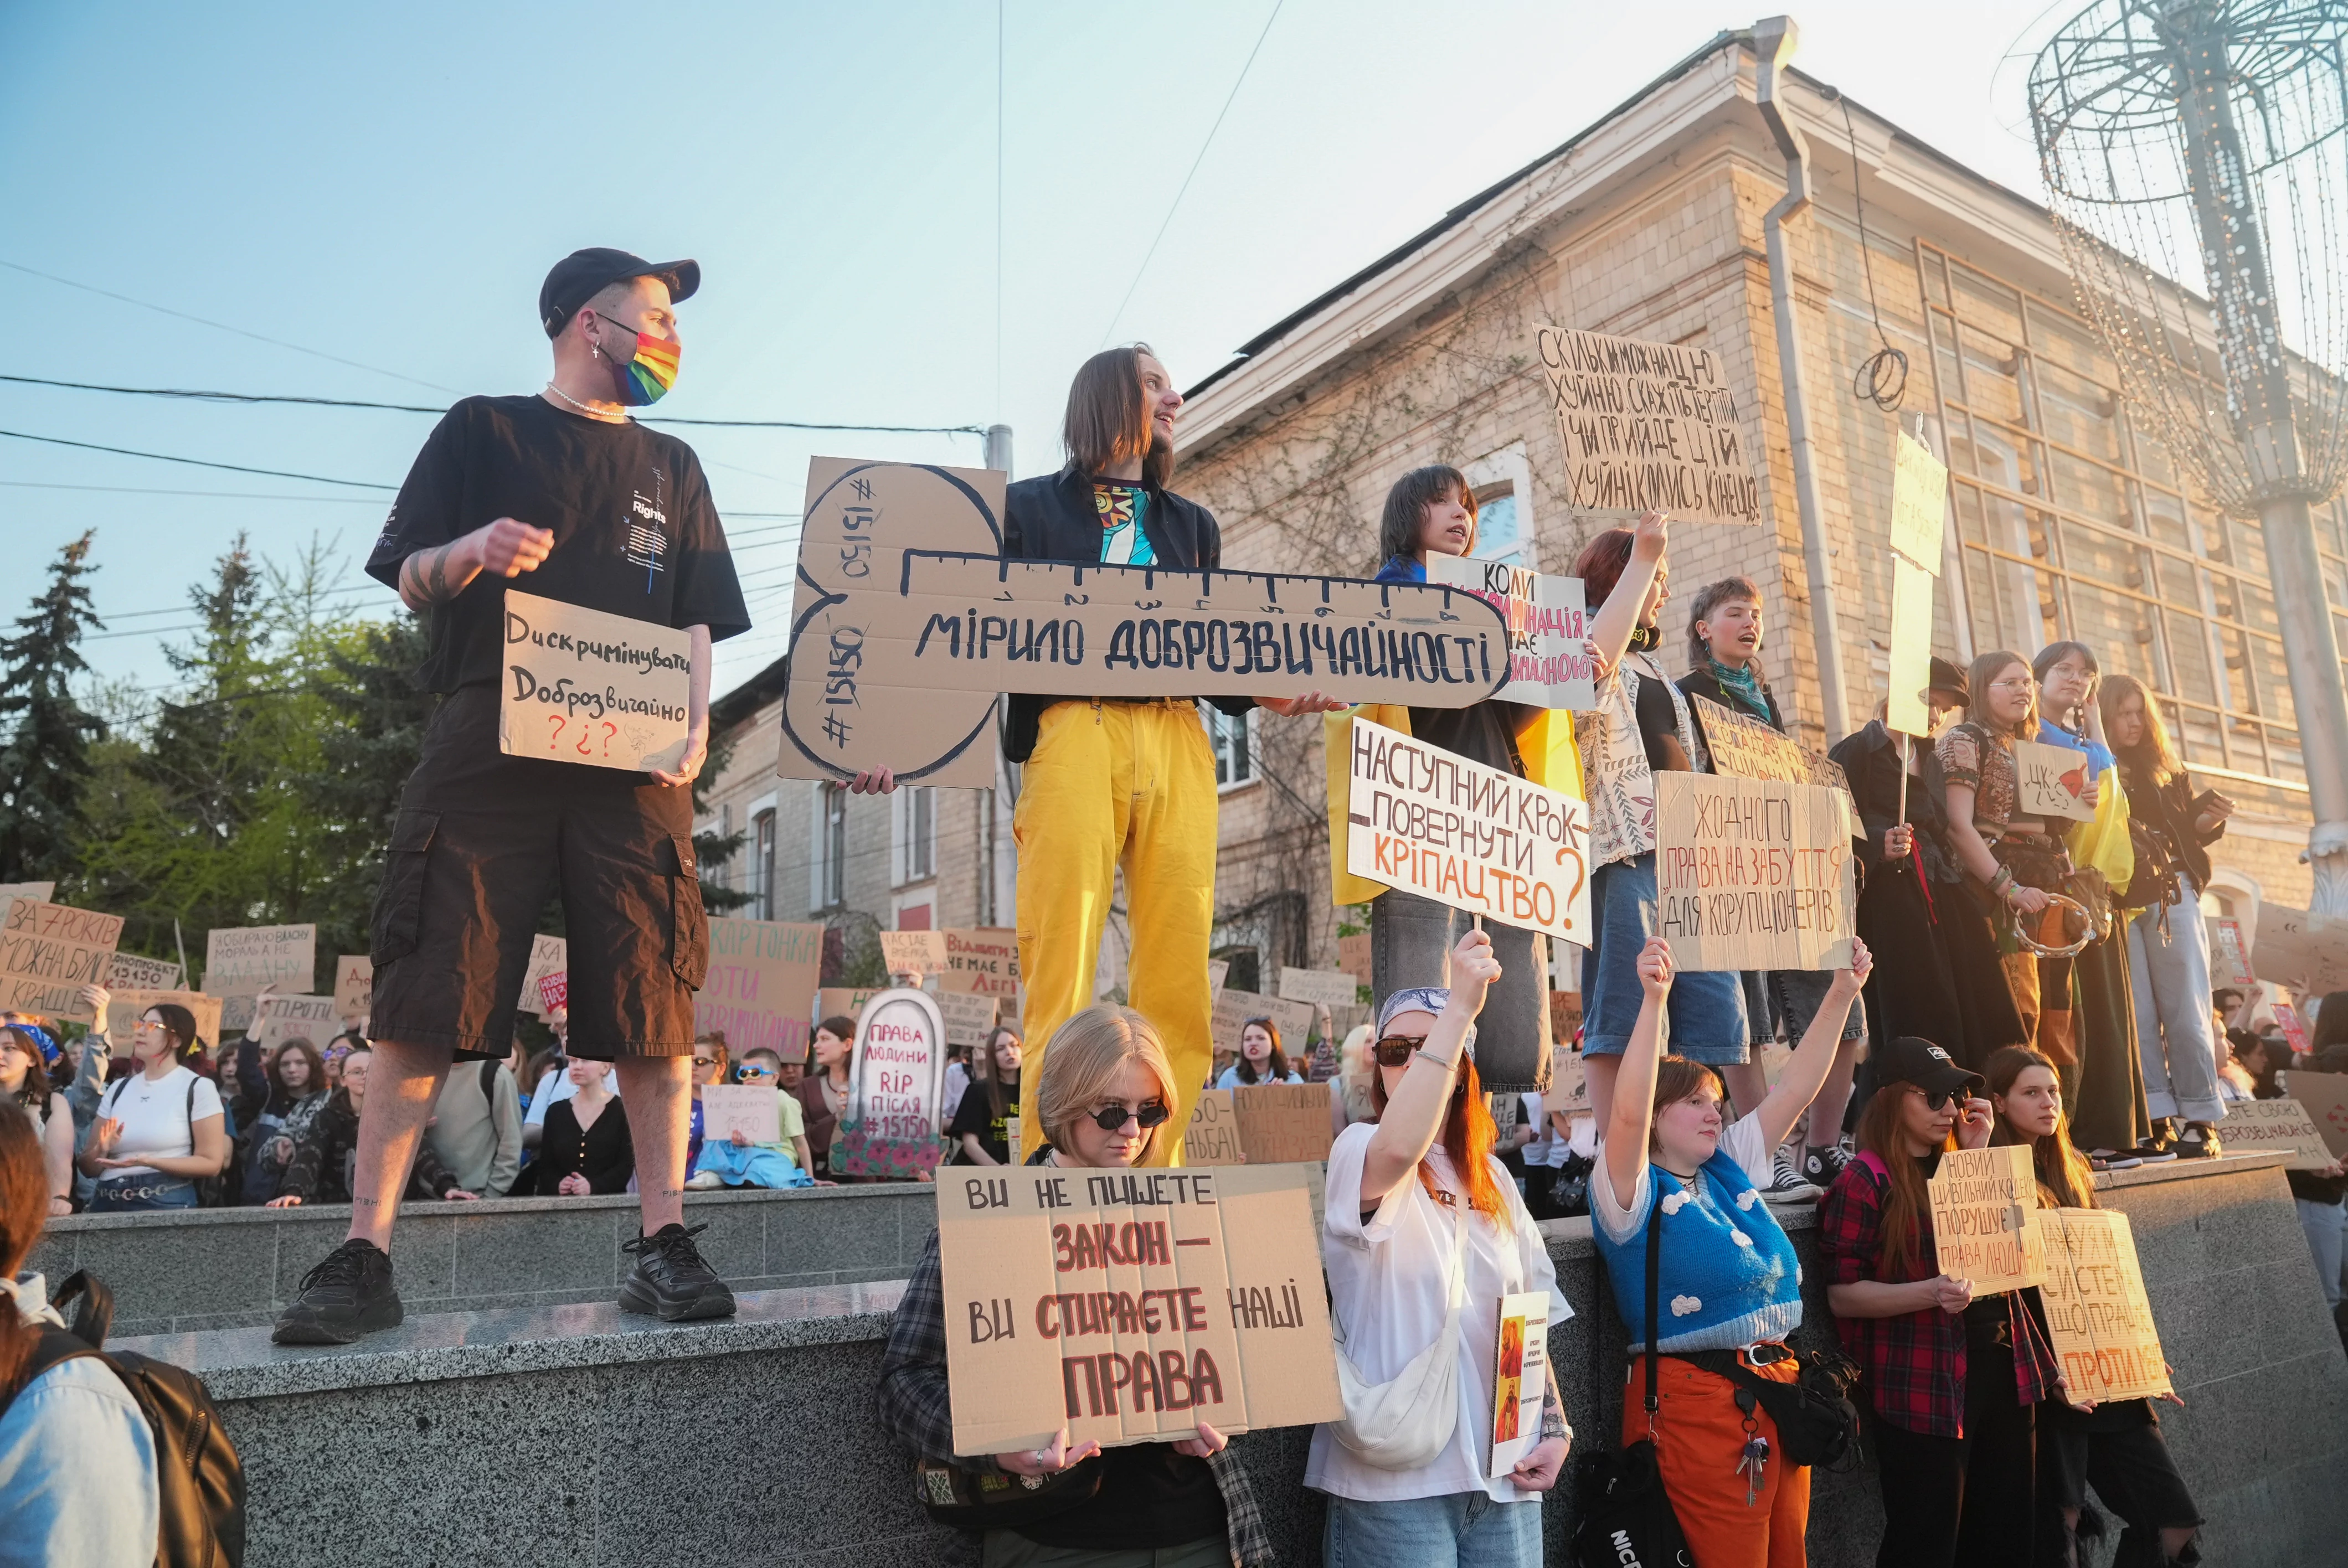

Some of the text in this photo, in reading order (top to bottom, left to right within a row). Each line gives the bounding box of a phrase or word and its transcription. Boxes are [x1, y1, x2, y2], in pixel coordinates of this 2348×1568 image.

[632, 500, 666, 524] Rights
[1484, 564, 1535, 602] КОЛИ
[1353, 726, 1510, 825] НАСТУПНИЙ
[1692, 793, 1790, 842] ЖОДНОГО
[1726, 846, 1746, 886] НА
[7, 899, 37, 933] ЗА
[40, 906, 63, 935] 7
[59, 910, 120, 945] РОКІВ
[1665, 889, 1835, 938] ДЛЯ КОРУПЦІОНЕРІВ
[870, 1024, 924, 1044] ПРАВА
[864, 1045, 928, 1064] ЛЮДИНИ
[1948, 1148, 1995, 1180] НОВИЙ
[965, 1174, 1217, 1209] ВИ НЕ ПИШЕТЕ
[1052, 1220, 1172, 1272] ЗАКОН
[1940, 1236, 2045, 1276] ПРАВА ЛЮДИНИ
[969, 1278, 1304, 1344] ВИ СТИРАЄТЕ НАШІ
[1062, 1348, 1224, 1420] ПРАВА
